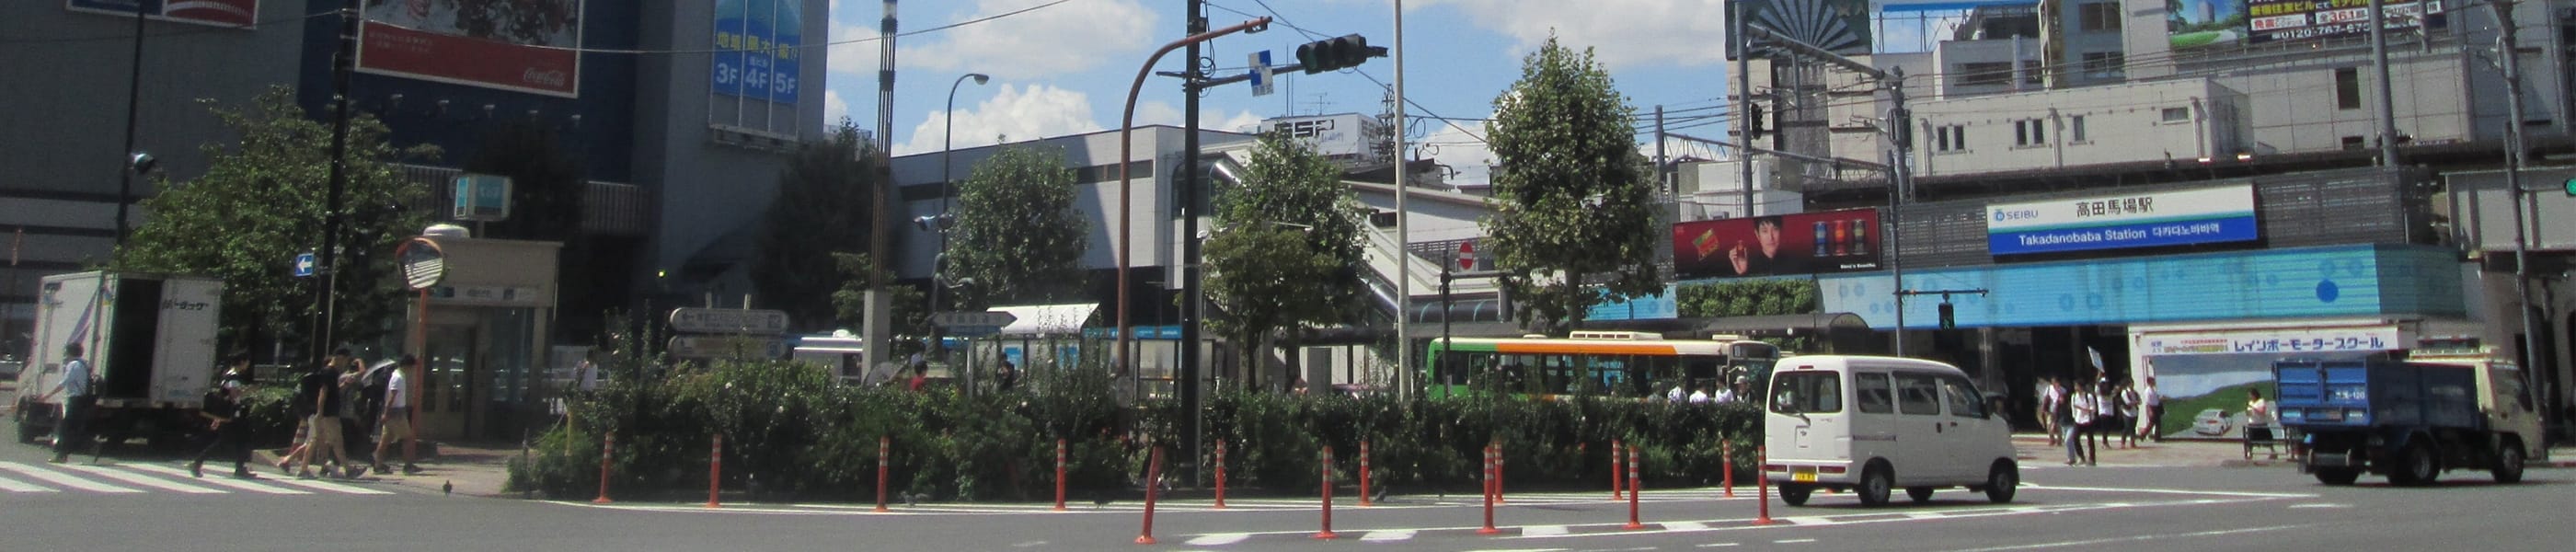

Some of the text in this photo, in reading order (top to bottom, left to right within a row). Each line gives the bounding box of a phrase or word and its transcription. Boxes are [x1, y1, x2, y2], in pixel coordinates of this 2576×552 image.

[717, 63, 738, 85] 3F
[746, 68, 767, 89] 4F
[775, 73, 796, 94] 5F
[2007, 197, 2155, 221] SEIBU 高田馬場駅
[2018, 232, 2102, 247] Takadanobaba
[2105, 229, 2146, 242] Station
[2234, 337, 2385, 352] レインボーモータースクール
